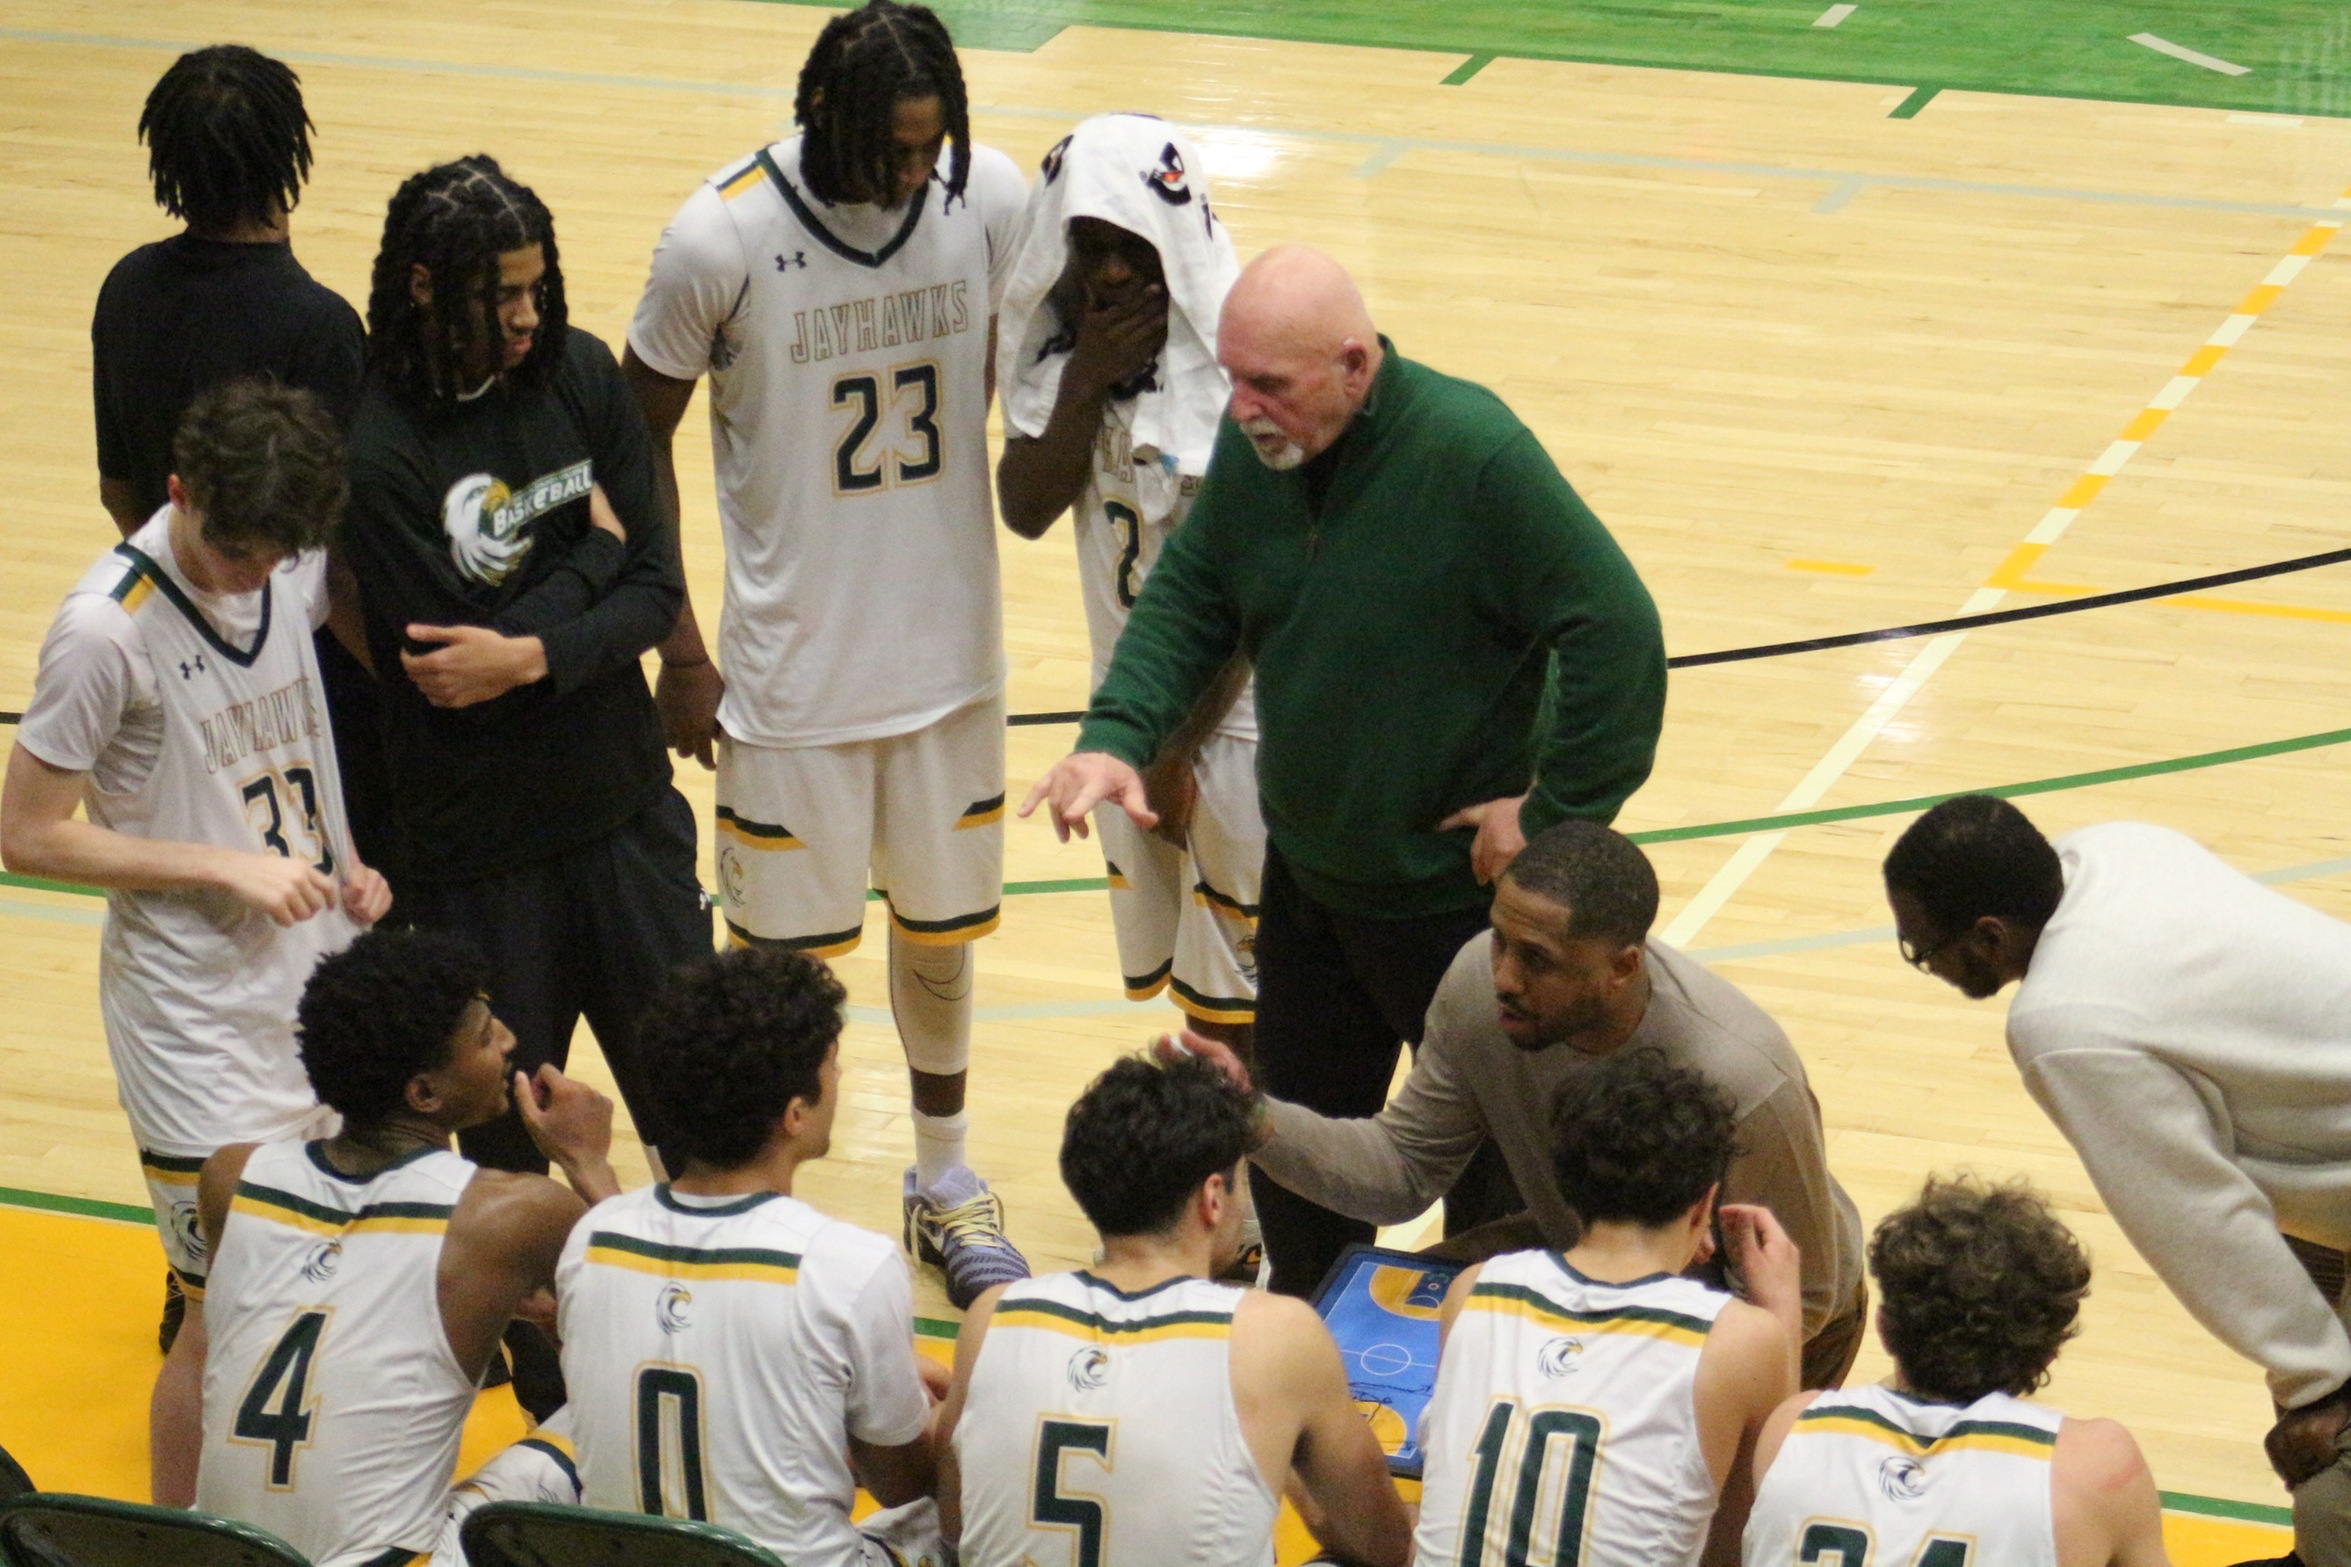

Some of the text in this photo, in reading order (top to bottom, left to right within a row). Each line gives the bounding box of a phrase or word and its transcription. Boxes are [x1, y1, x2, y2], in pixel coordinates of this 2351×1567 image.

[789, 279, 969, 364] JAYHAWKS
[828, 356, 946, 498] 23
[227, 1304, 337, 1494] 4
[629, 1359, 716, 1524] 0
[1025, 1411, 1120, 1567] 5
[1454, 1393, 1610, 1567] 10
